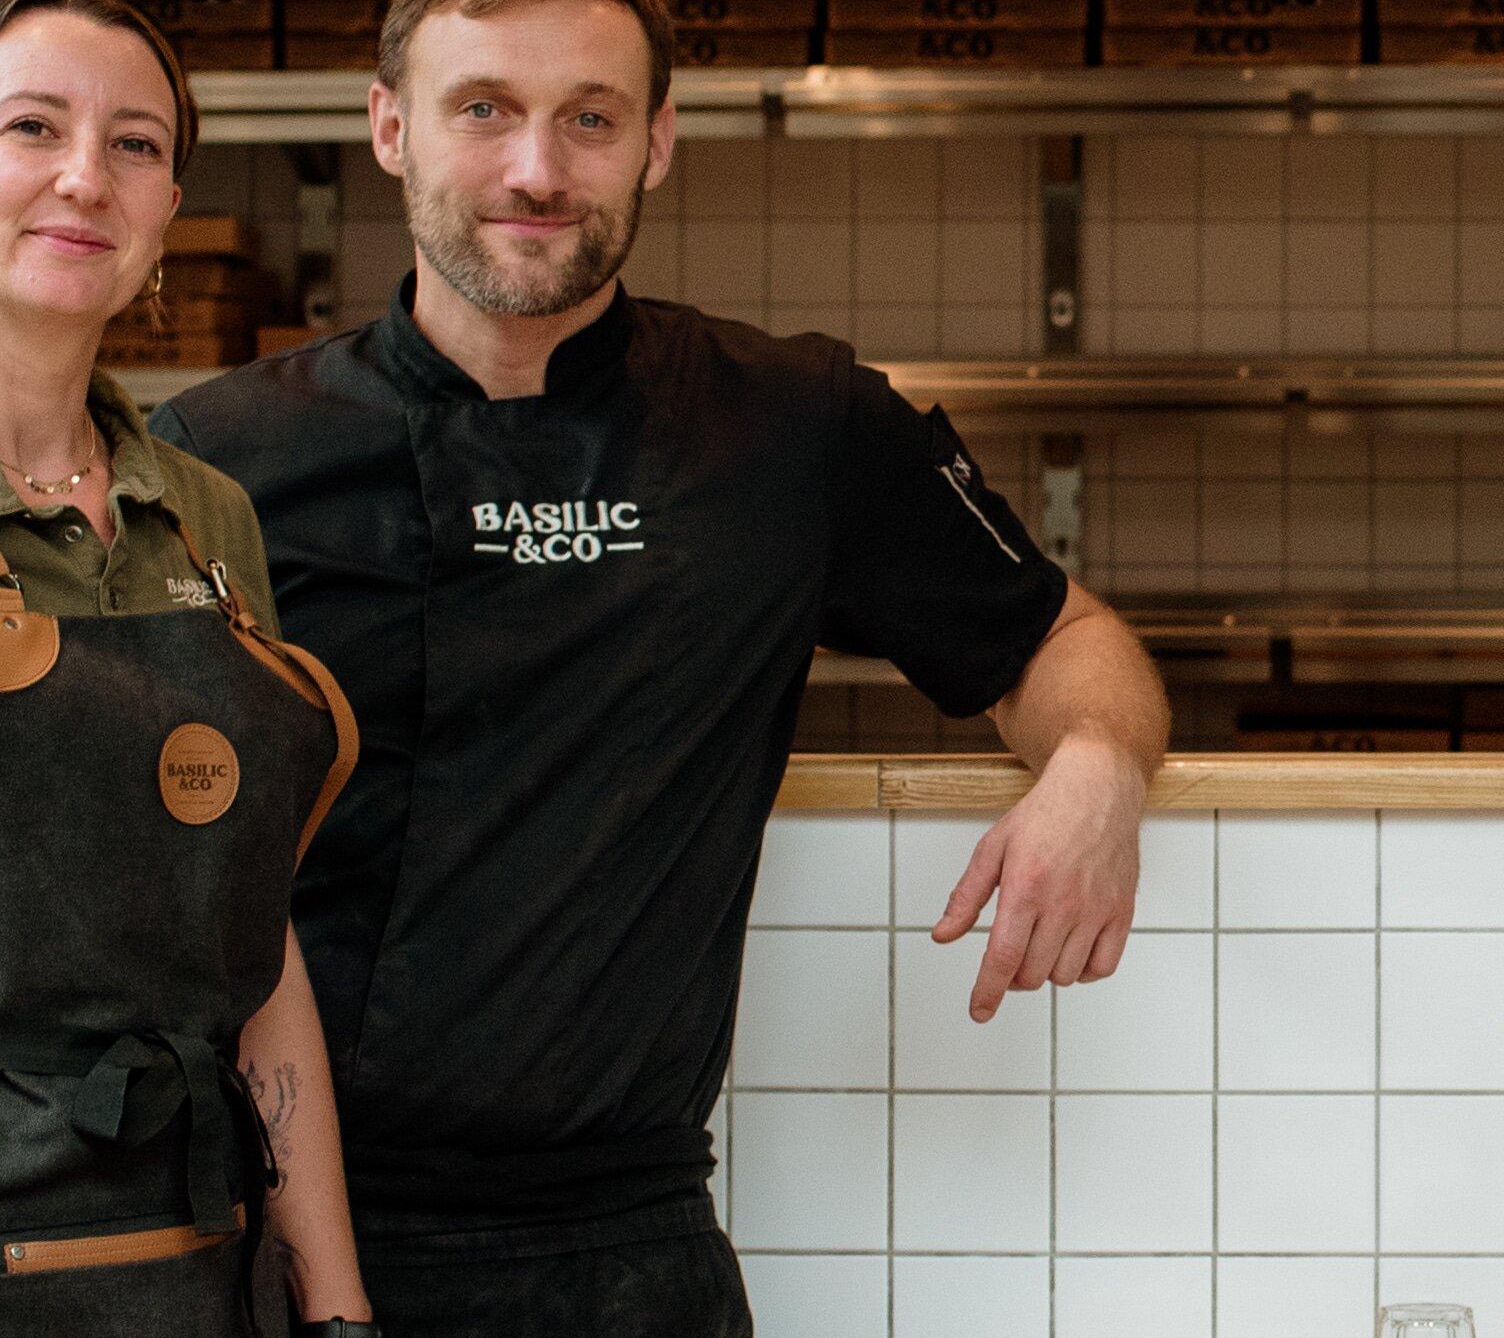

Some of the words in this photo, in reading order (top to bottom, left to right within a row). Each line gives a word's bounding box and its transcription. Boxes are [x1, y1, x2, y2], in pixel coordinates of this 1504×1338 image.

[472, 501, 640, 533] BASILIC
[512, 533, 602, 564] &CO
[167, 763, 227, 777] BASILIC
[179, 778, 212, 791] &CO
